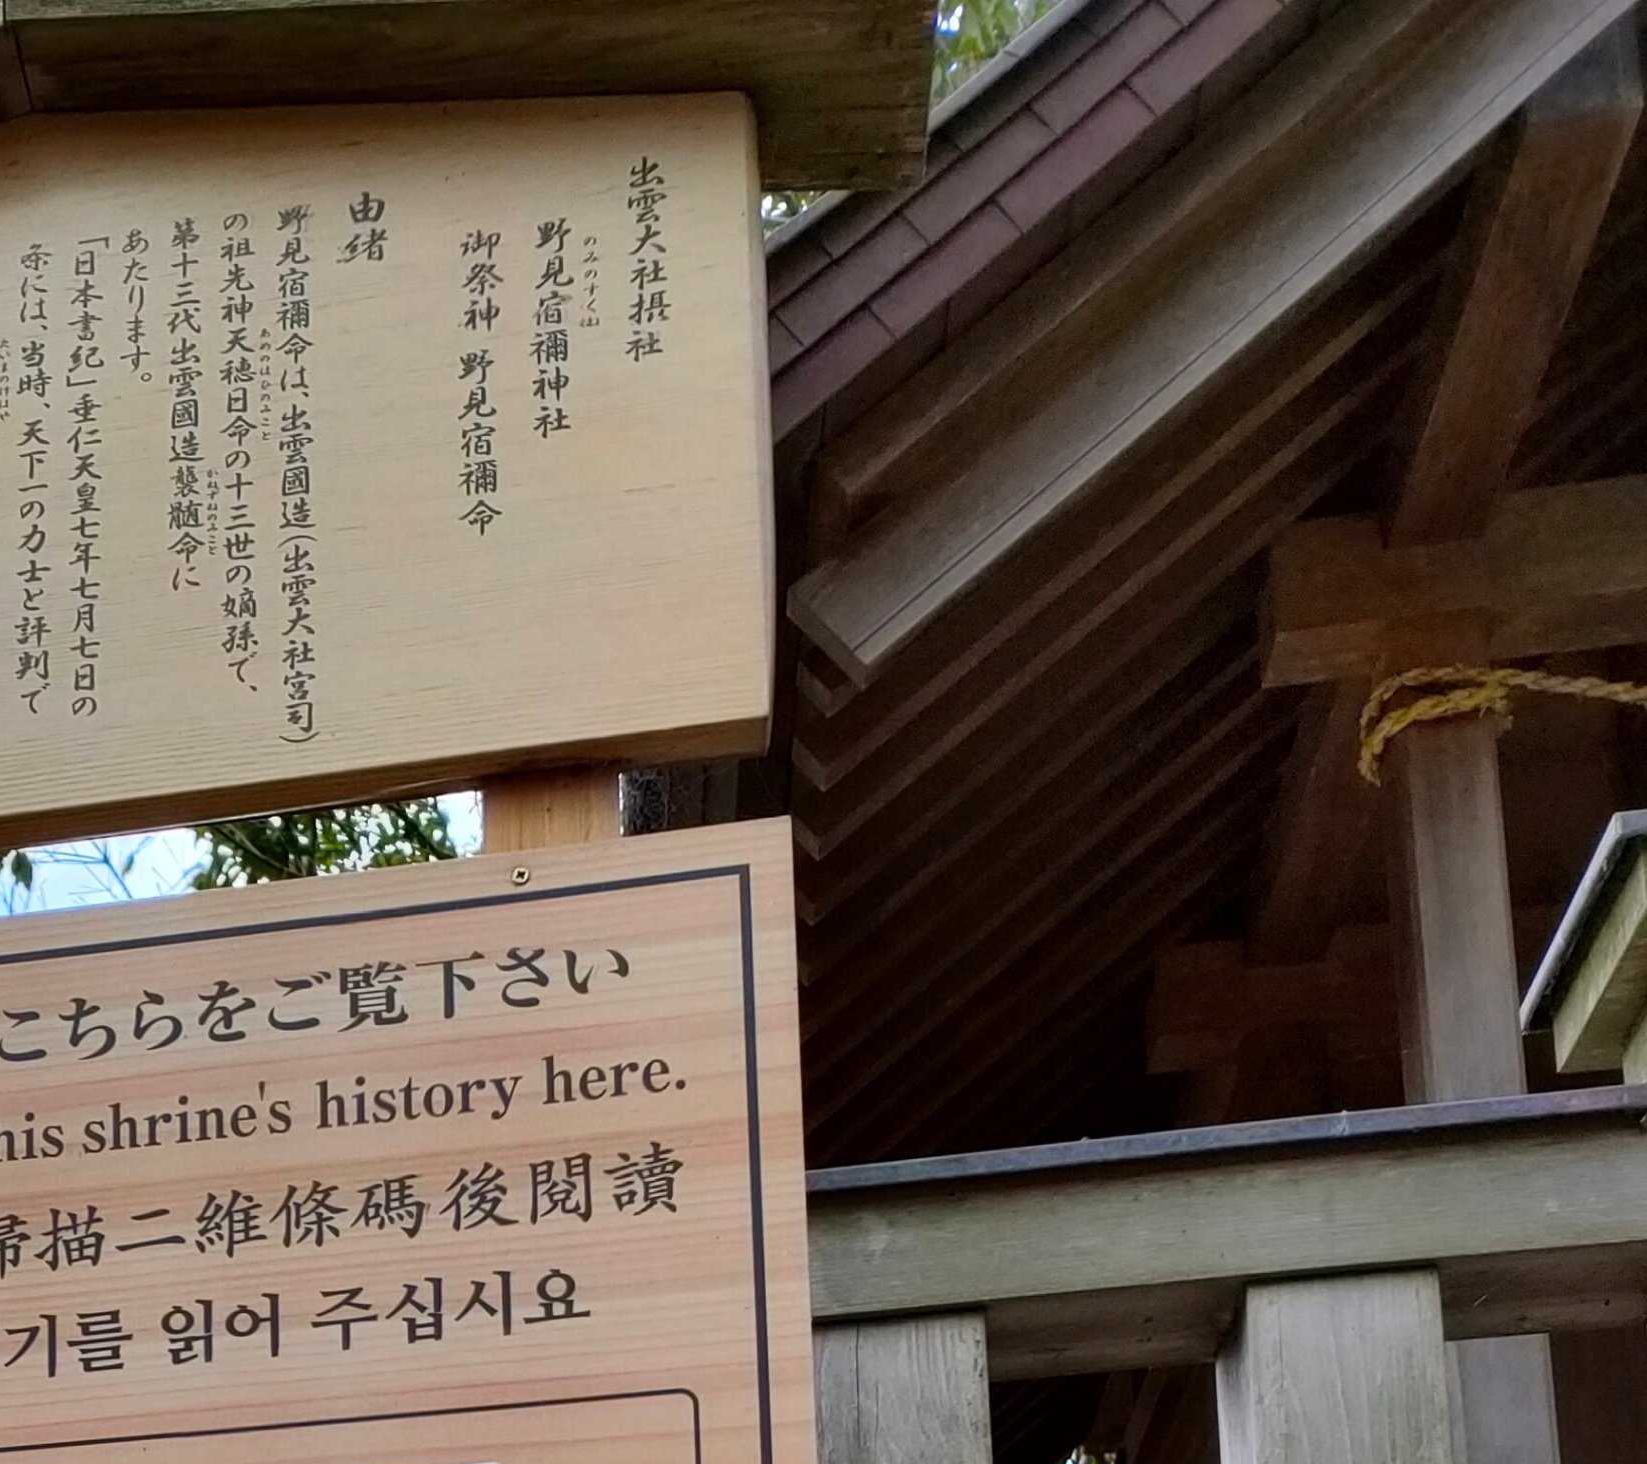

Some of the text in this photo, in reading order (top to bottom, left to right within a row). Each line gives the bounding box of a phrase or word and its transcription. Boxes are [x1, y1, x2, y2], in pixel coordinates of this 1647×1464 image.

[337, 191, 389, 263] 由緒
[624, 156, 672, 362] 出雲大社摂社
[119, 228, 153, 382] あたります。
[457, 229, 504, 537] 御祭神 野見宿禰命
[82, 1080, 292, 1156] shrine's
[315, 1067, 523, 1130] history
[541, 1054, 688, 1107] here.
[160, 1292, 282, 1366] 읽어
[309, 1268, 592, 1352] 주십시요
